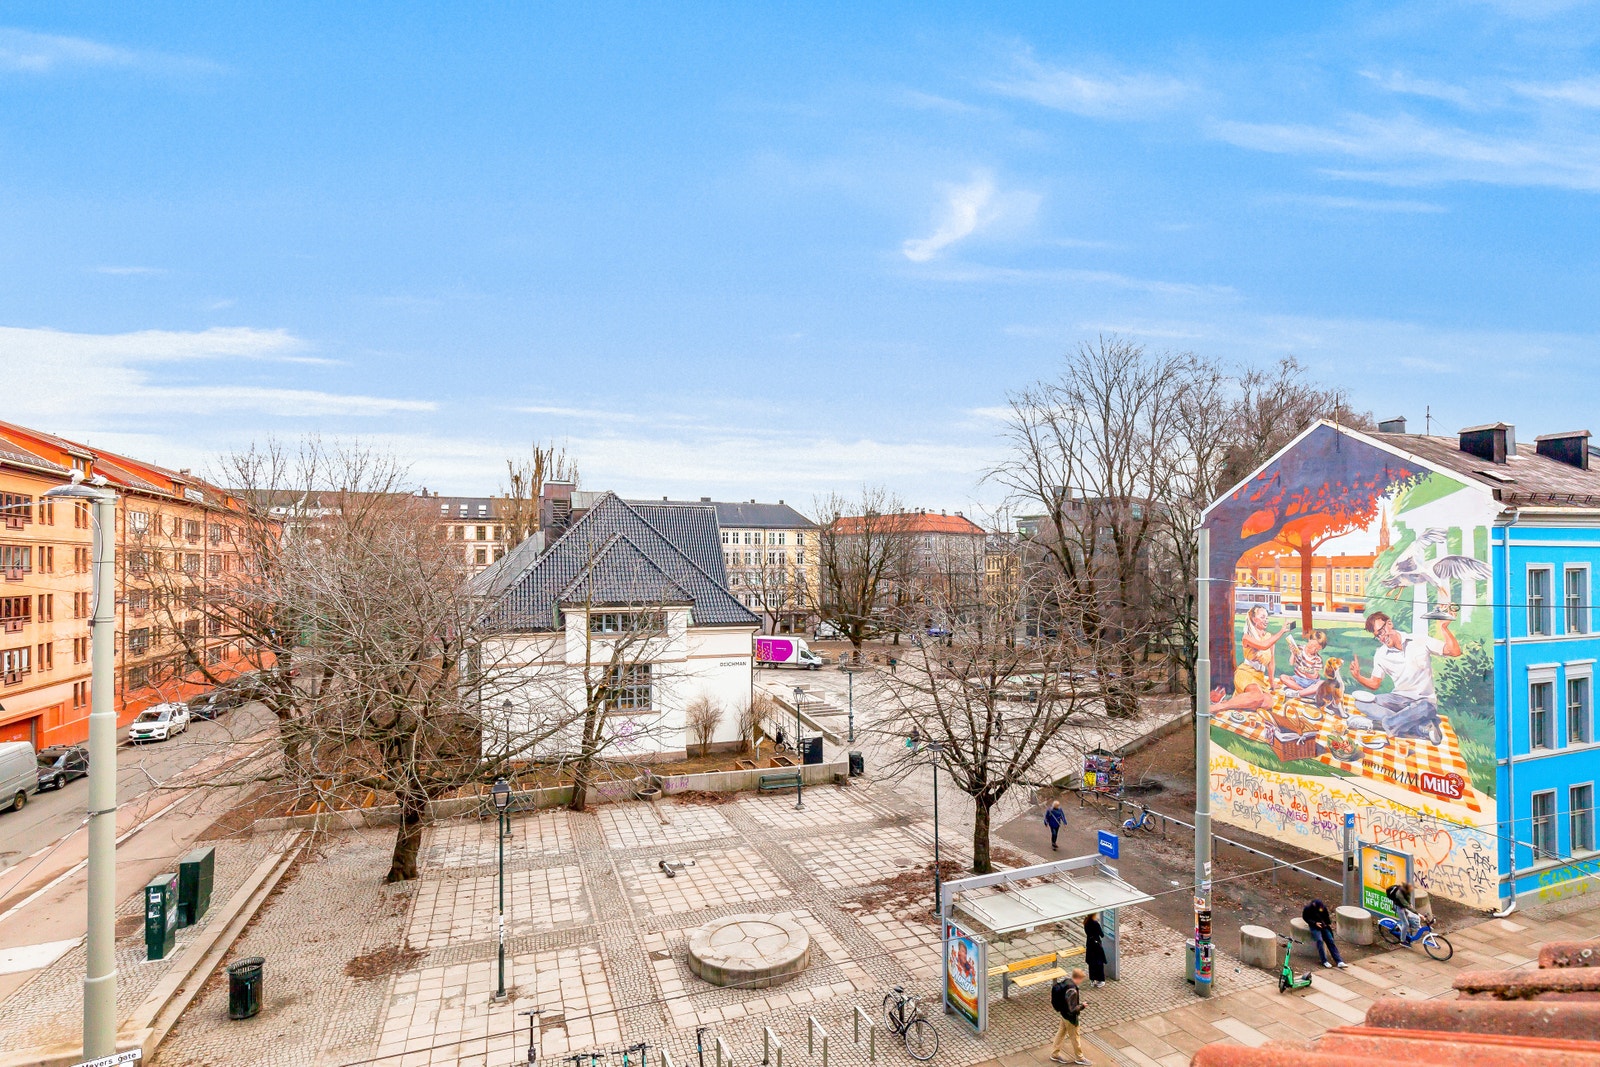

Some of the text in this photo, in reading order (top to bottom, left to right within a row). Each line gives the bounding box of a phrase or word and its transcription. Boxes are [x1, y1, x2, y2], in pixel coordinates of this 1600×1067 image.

[1423, 775, 1460, 797] Mills
[1210, 773, 1232, 803] Jeg
[1236, 787, 1247, 796] er
[1249, 786, 1275, 805] glad
[1291, 796, 1309, 822] deg
[1374, 825, 1417, 849] pappa
[1365, 890, 1380, 900] TASTE
[1366, 897, 1380, 908] NEW
[118, 1053, 137, 1063] gate
